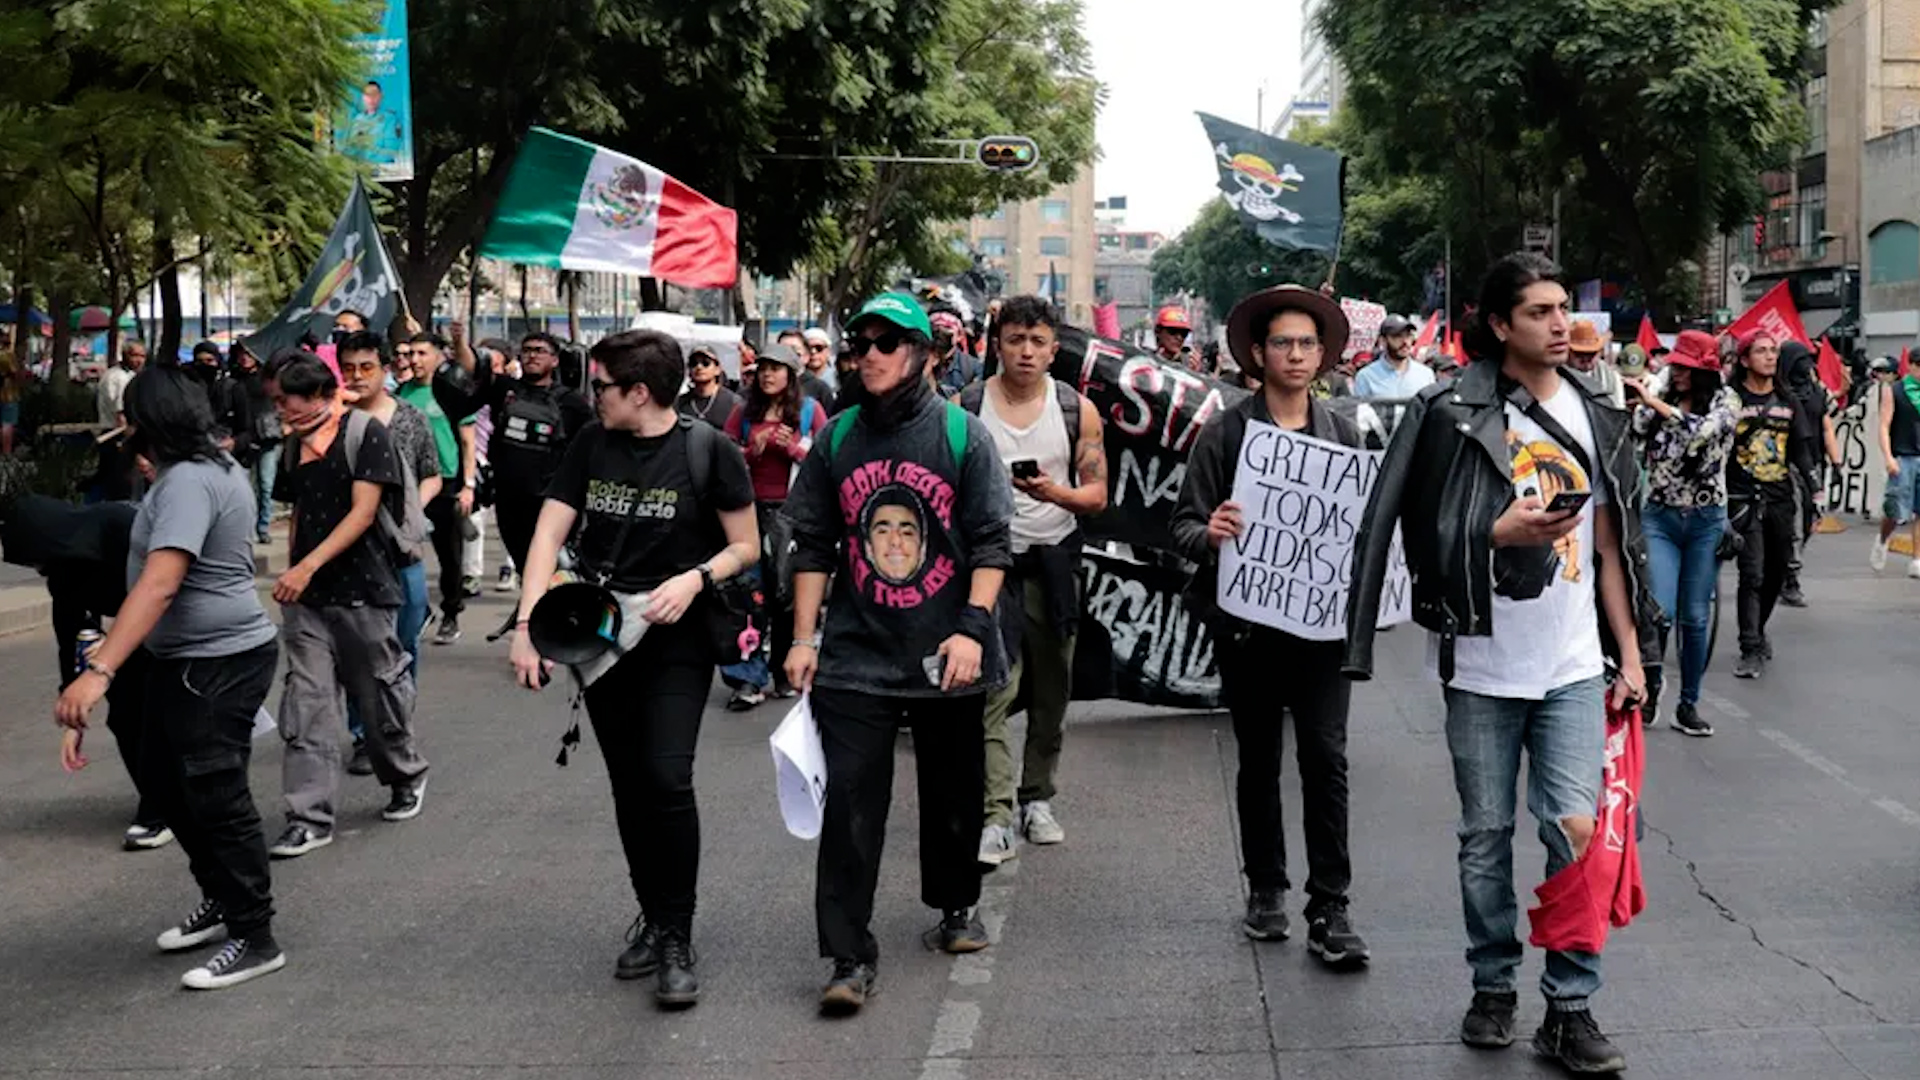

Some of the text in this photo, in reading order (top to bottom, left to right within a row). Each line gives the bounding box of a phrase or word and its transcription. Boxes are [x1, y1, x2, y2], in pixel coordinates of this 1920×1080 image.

[894, 461, 957, 530] DEATH
[1256, 481, 1354, 546] TODAS
[1233, 522, 1336, 586] VIDAS
